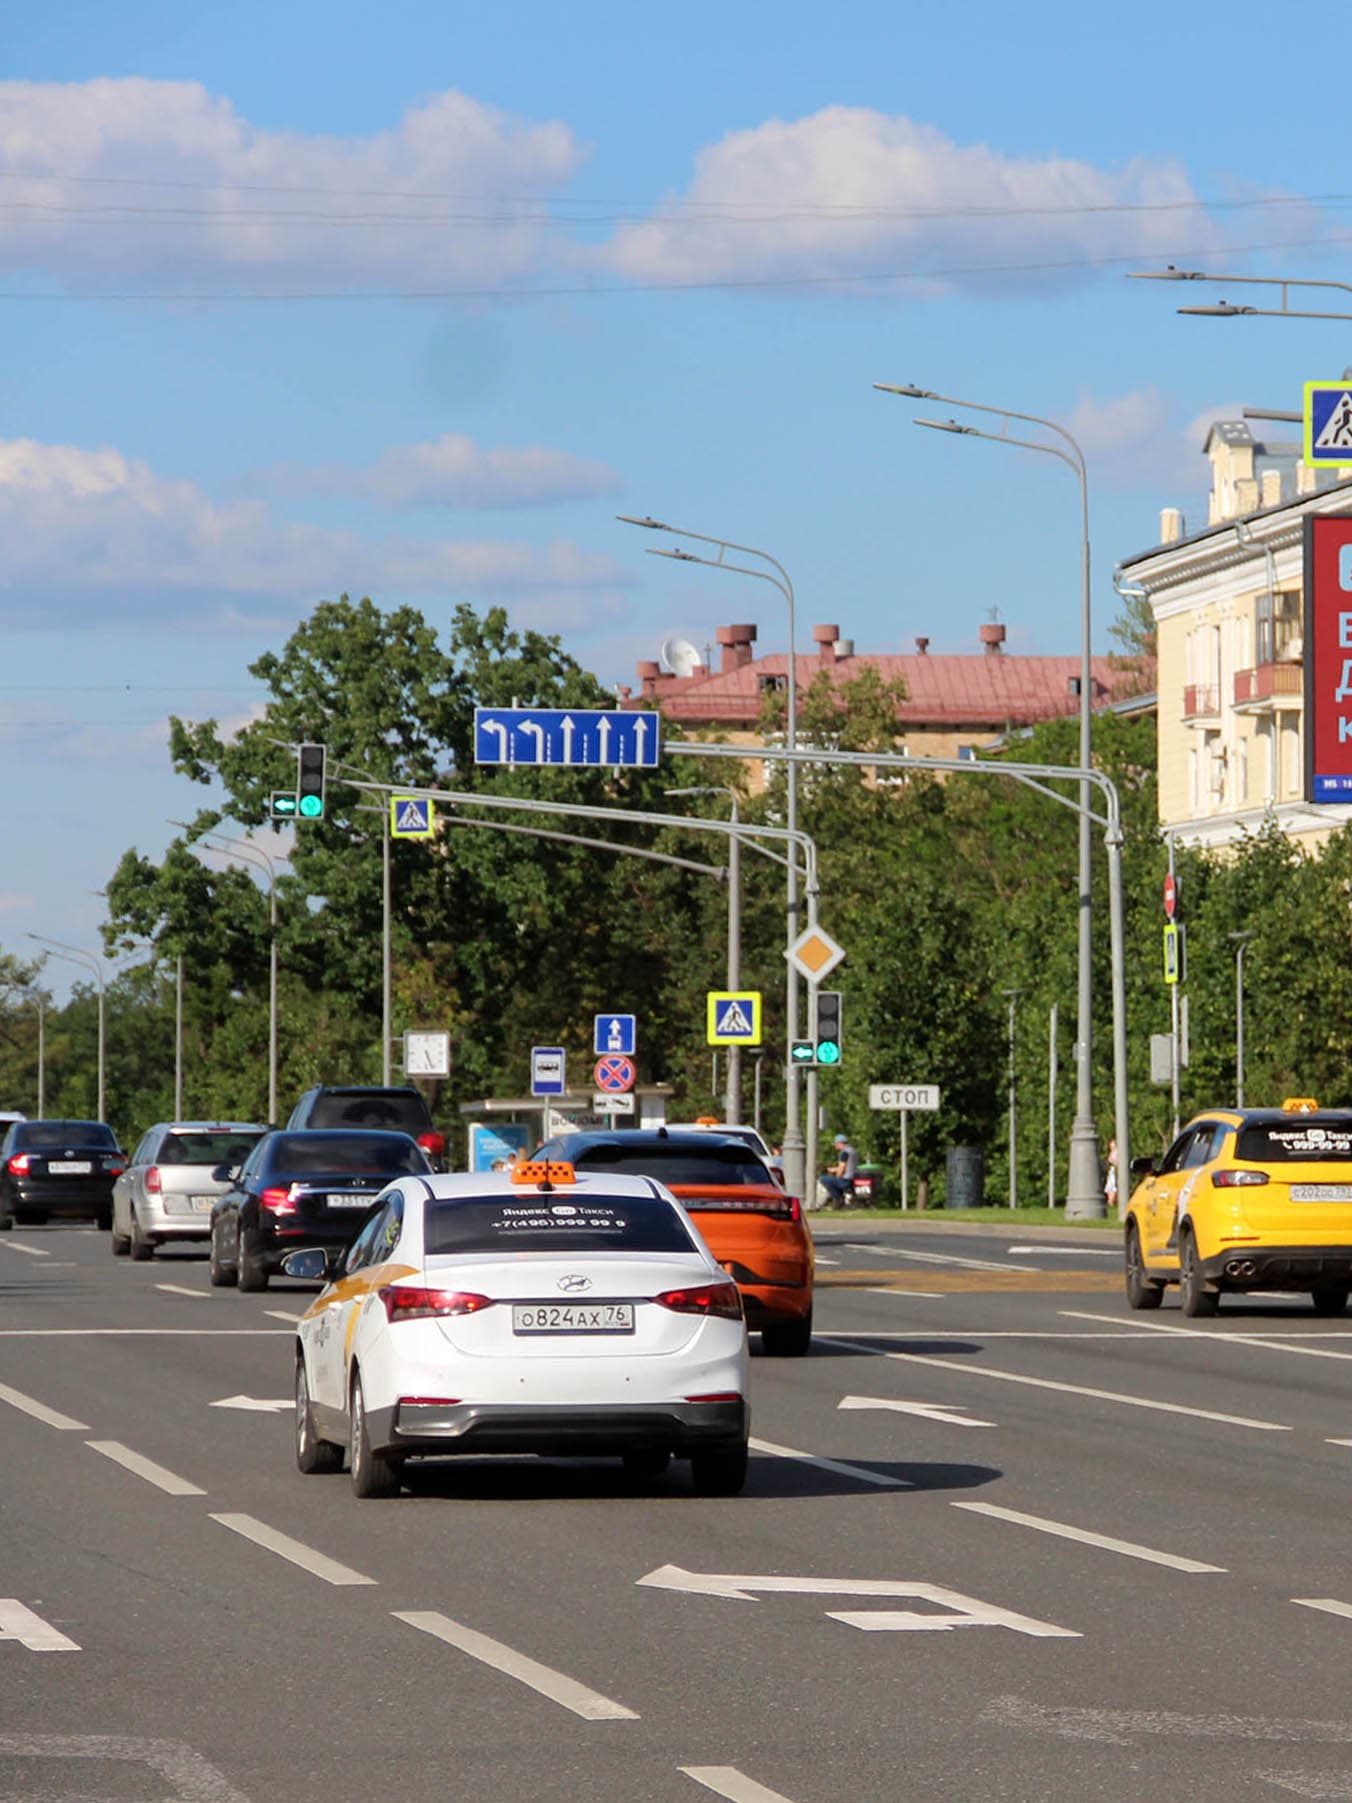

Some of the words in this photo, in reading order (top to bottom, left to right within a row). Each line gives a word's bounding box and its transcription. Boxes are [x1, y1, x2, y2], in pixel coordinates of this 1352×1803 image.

[881, 1089, 929, 1104] СТОП
[1268, 1131, 1305, 1141] Яндекс
[502, 1207, 550, 1217] Яндекс
[578, 1206, 614, 1216] Такси
[522, 1308, 600, 1327] О824АХ
[606, 1307, 625, 1321] 76
